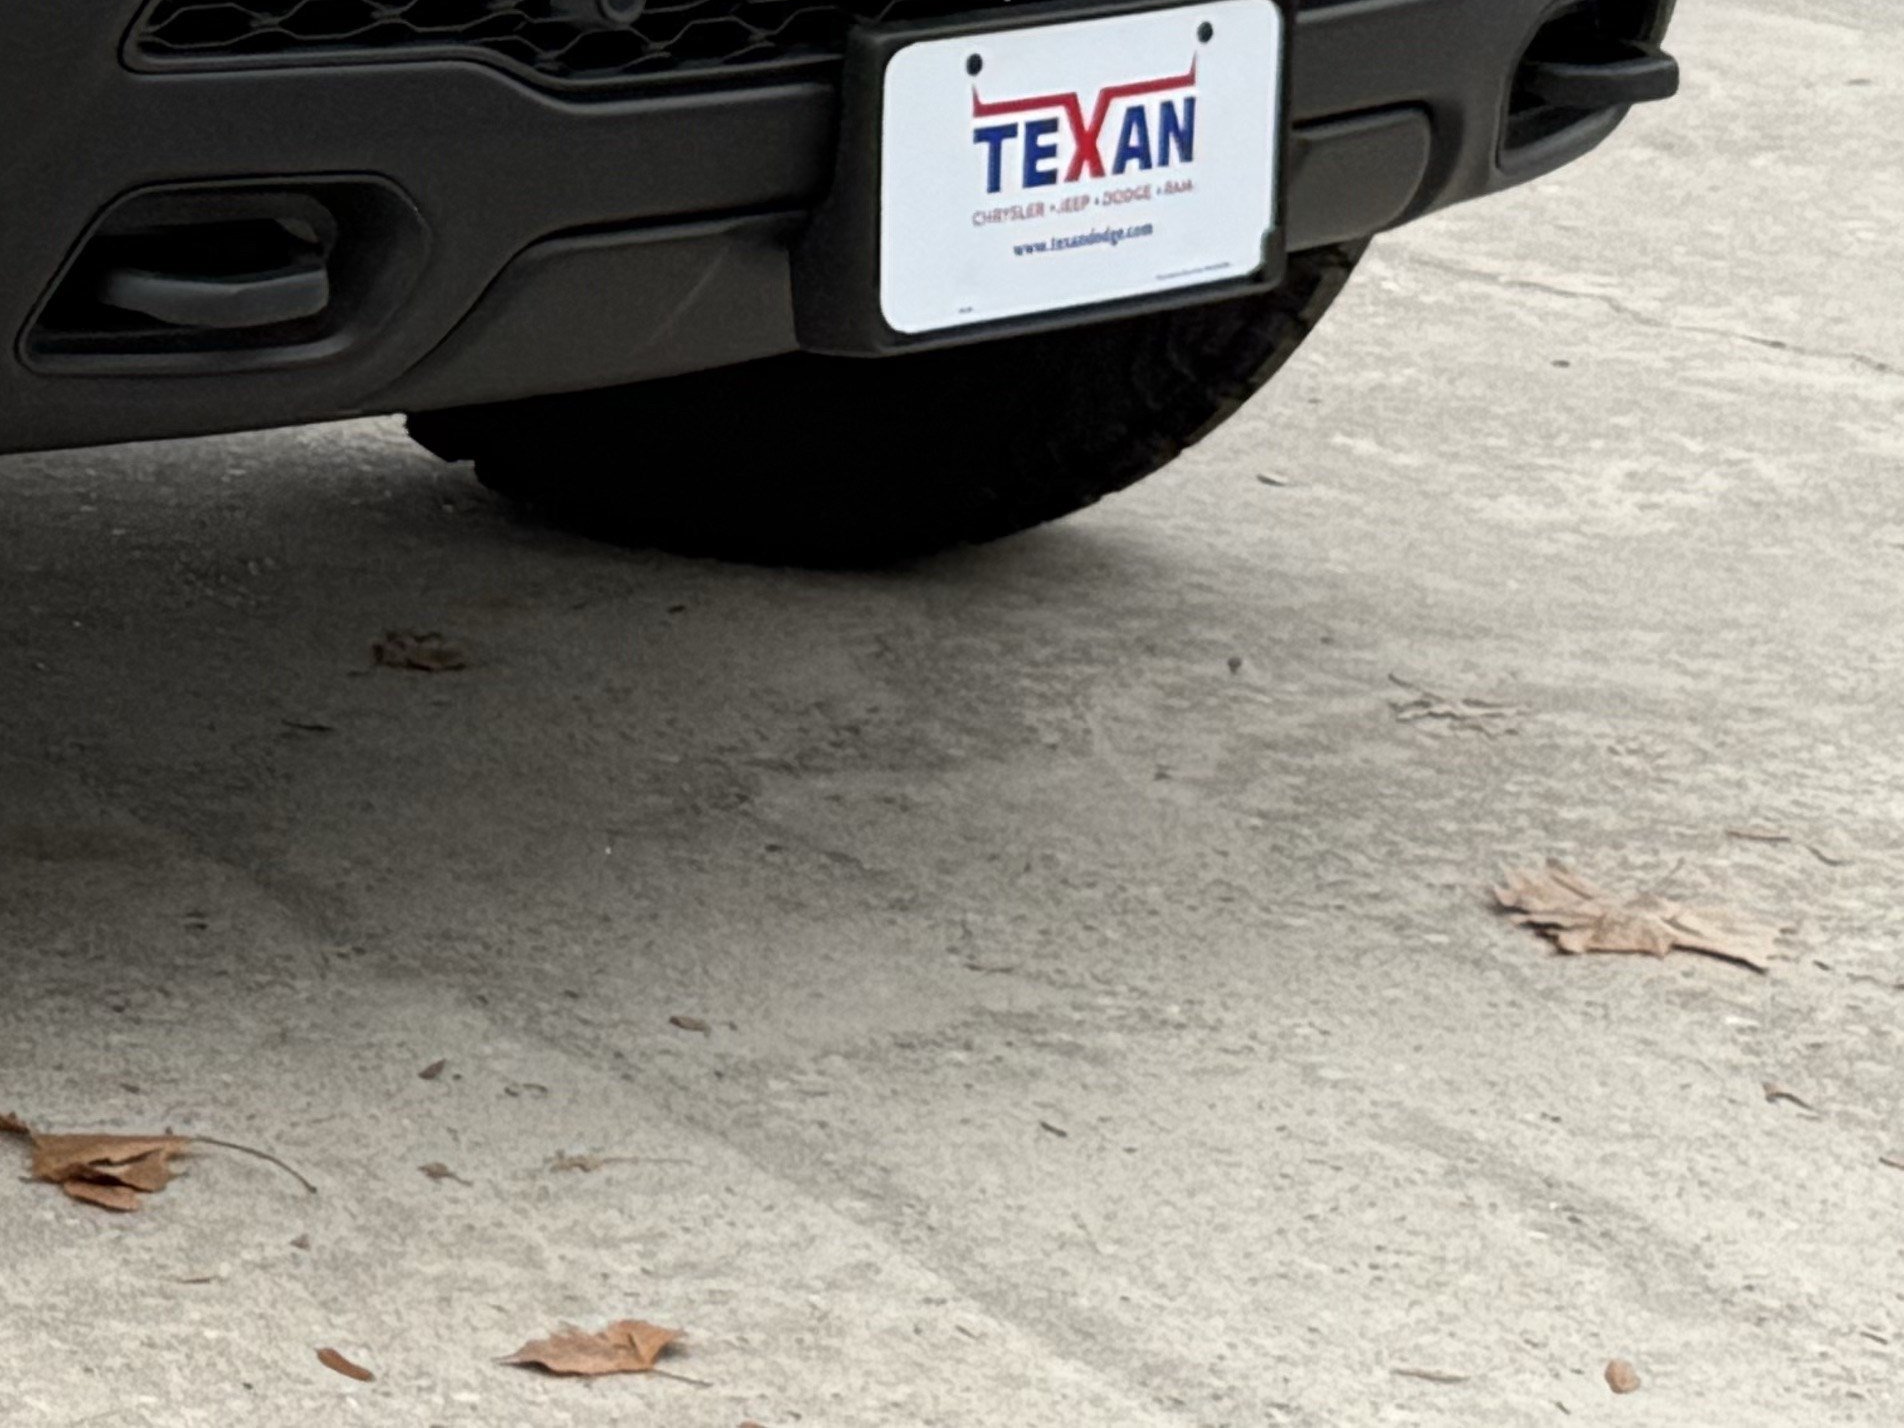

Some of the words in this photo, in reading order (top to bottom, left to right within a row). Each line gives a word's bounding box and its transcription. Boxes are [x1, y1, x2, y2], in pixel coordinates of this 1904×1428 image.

[972, 90, 1197, 195] TEXAN
[972, 201, 1045, 227] CHRYSLER
[1058, 194, 1090, 214] JEEP
[1101, 184, 1152, 207] DODGE
[1163, 179, 1194, 195] RAM
[1013, 222, 1154, 257] www.texandodge.com
